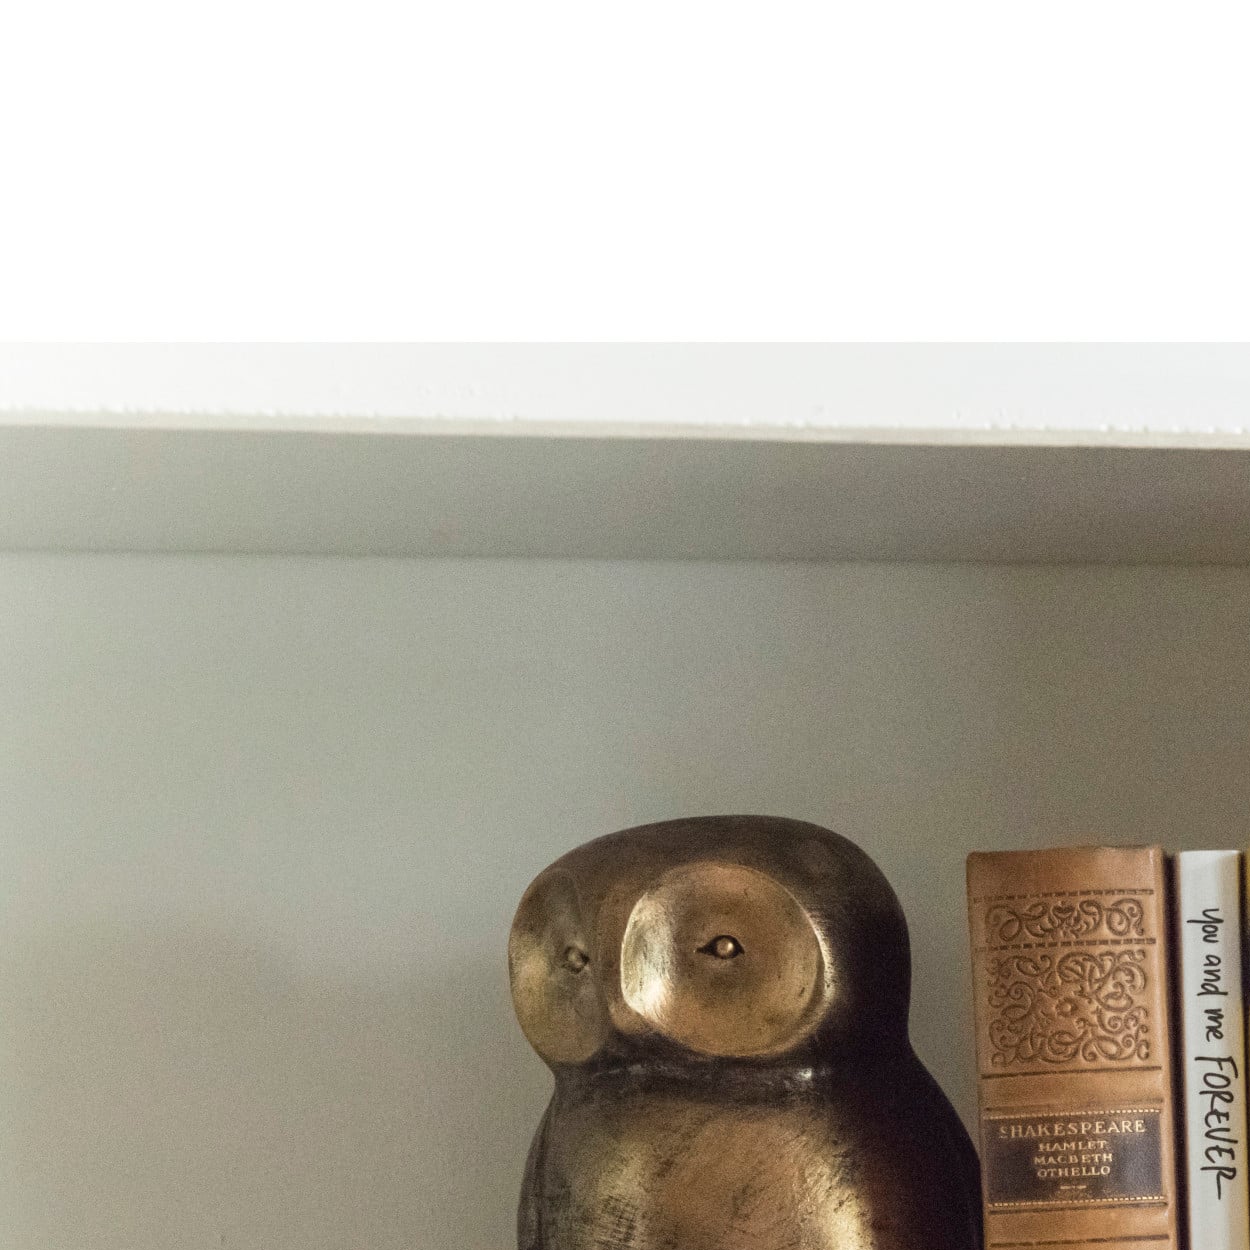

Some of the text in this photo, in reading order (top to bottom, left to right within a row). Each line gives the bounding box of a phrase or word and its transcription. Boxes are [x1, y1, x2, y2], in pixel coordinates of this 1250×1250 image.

[1196, 954, 1229, 996] and
[1204, 1008, 1225, 1042] me
[999, 1119, 1147, 1139] SHAKESPEARE
[1194, 1055, 1239, 1200] FOREVER
[1038, 1140, 1108, 1152] HAMLET
[1034, 1152, 1113, 1165] MACBETH
[1036, 1165, 1111, 1178] OTHELLO
